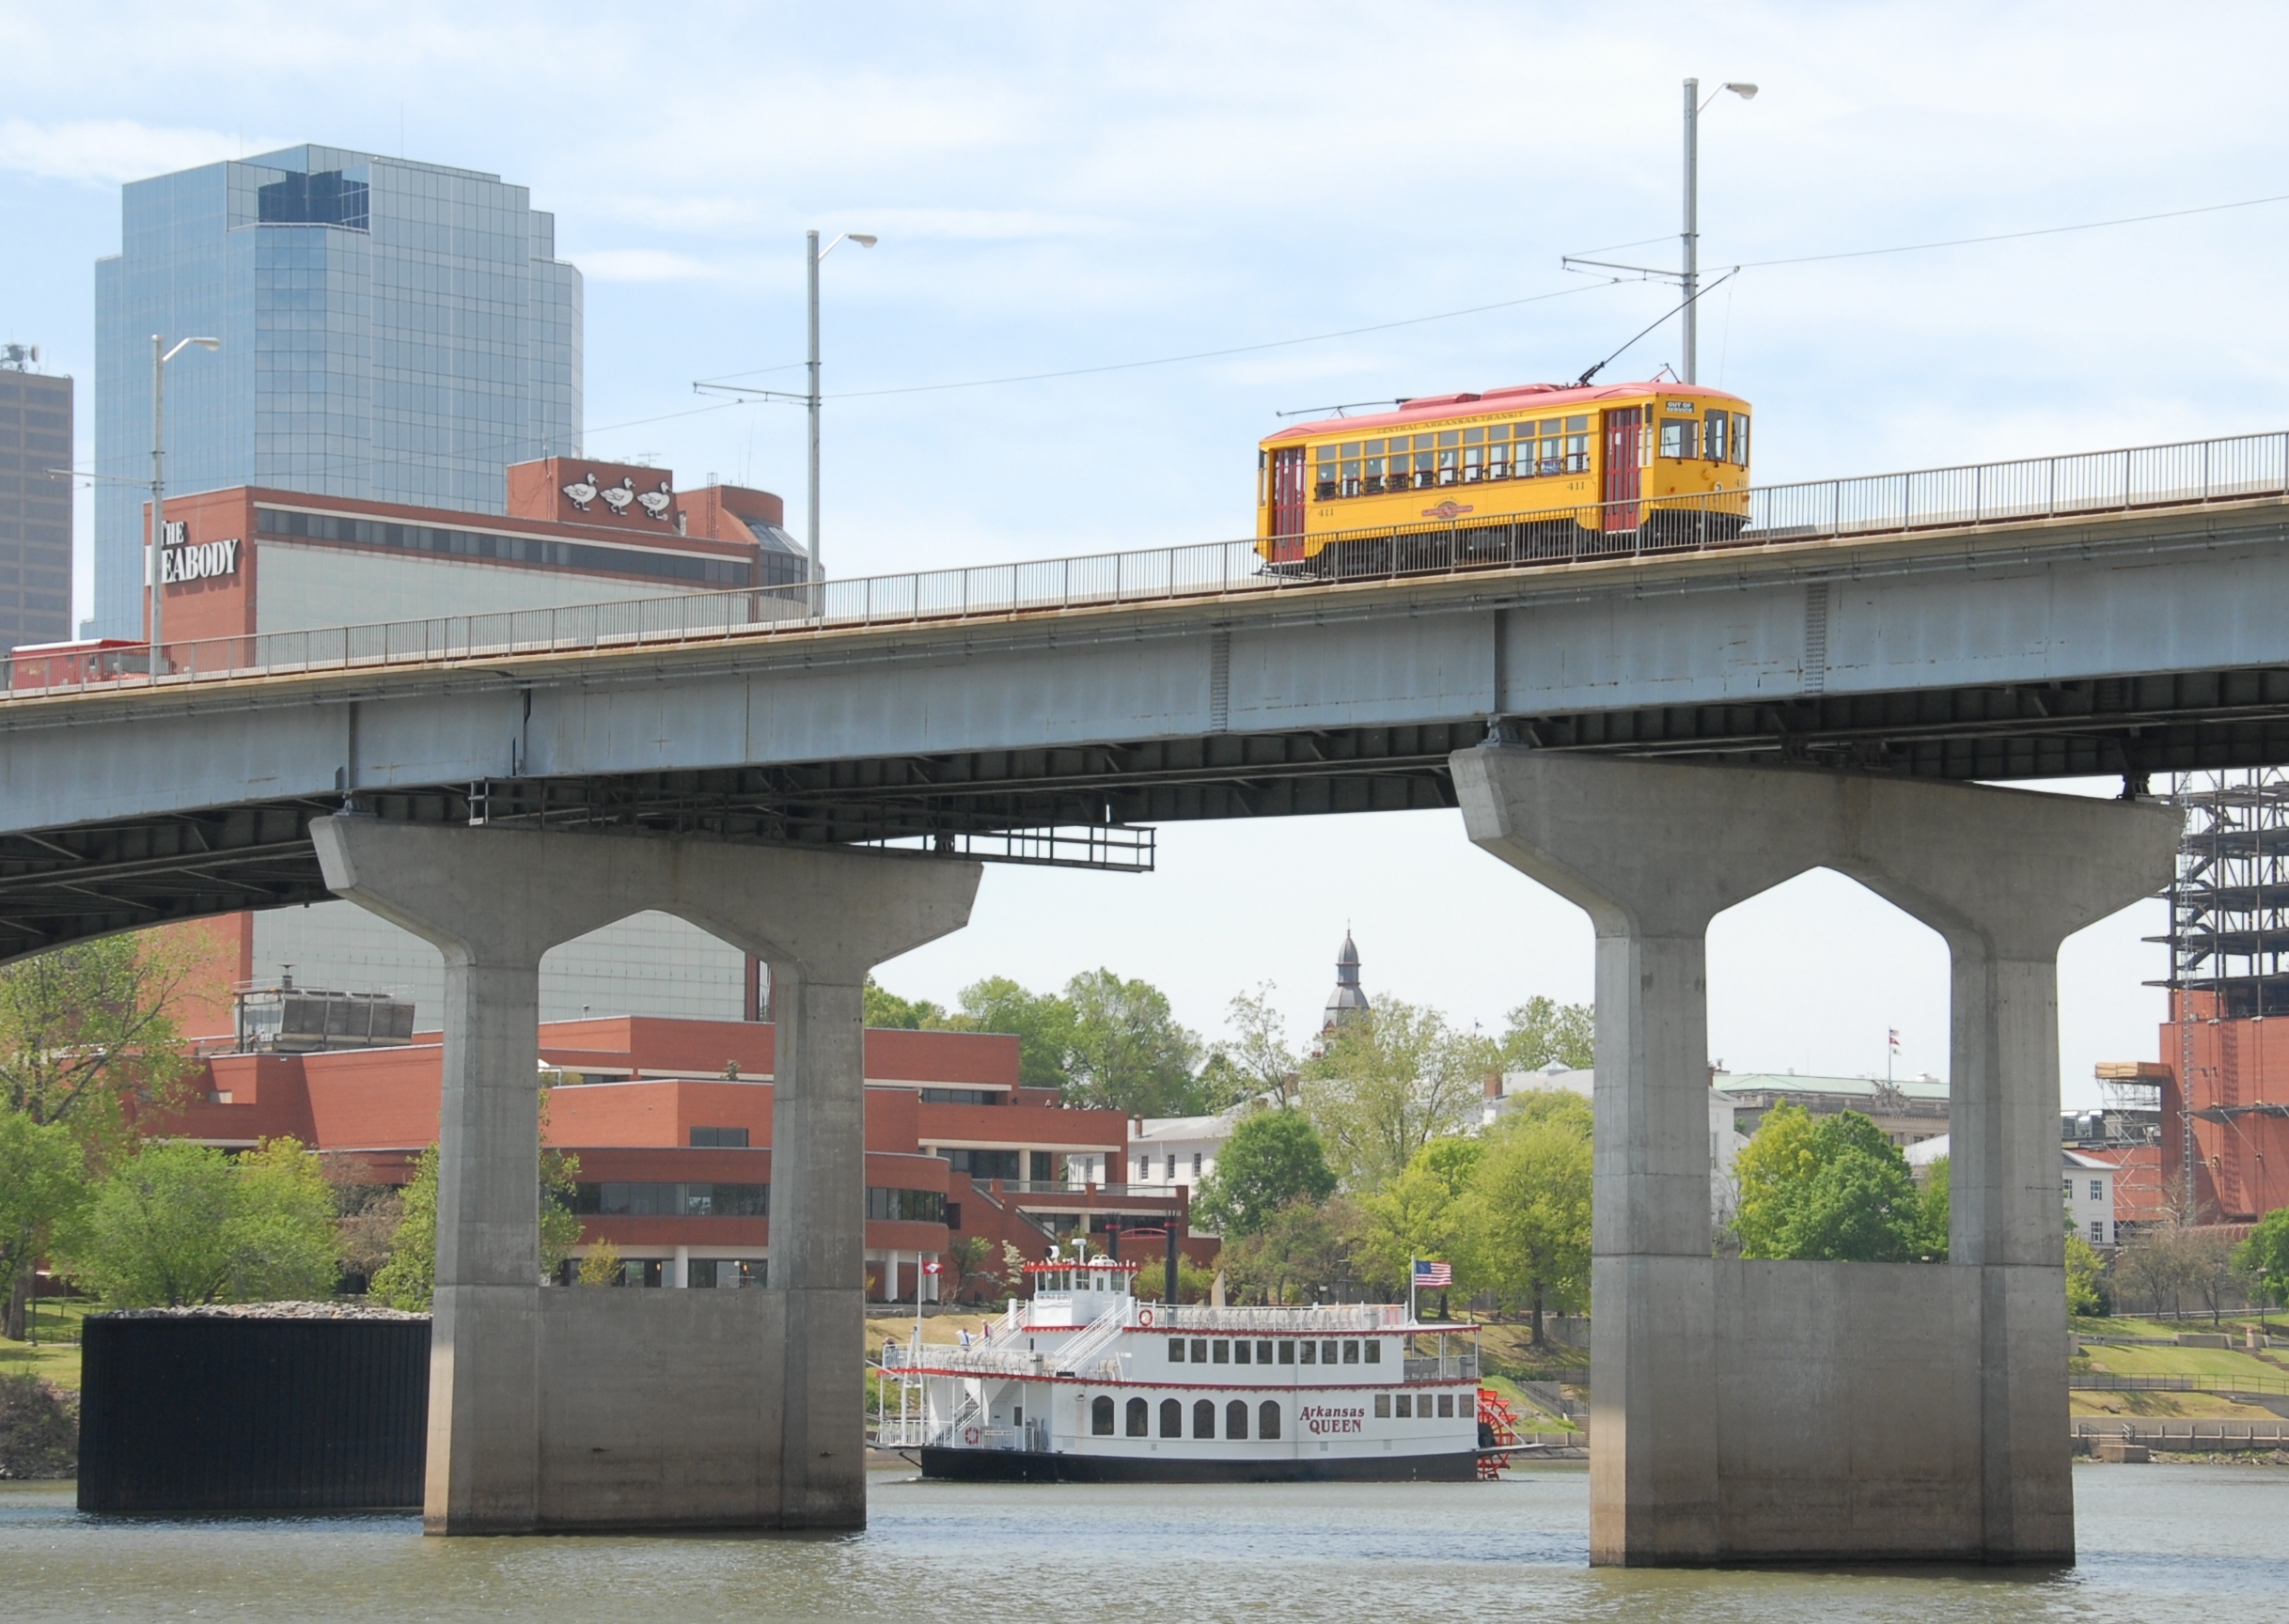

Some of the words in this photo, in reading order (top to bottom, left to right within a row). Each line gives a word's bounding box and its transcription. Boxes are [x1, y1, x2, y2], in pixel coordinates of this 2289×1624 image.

[1378, 423, 1419, 433] CENTRAL
[1423, 416, 1478, 427] ARKANSAS
[1482, 412, 1524, 421] TRANSIT
[1566, 481, 1585, 491] 411
[1735, 478, 1748, 489] 411
[1317, 508, 1334, 517] 411
[1299, 1405, 1365, 1421] Arkansas
[1309, 1419, 1361, 1435] QUEEN
